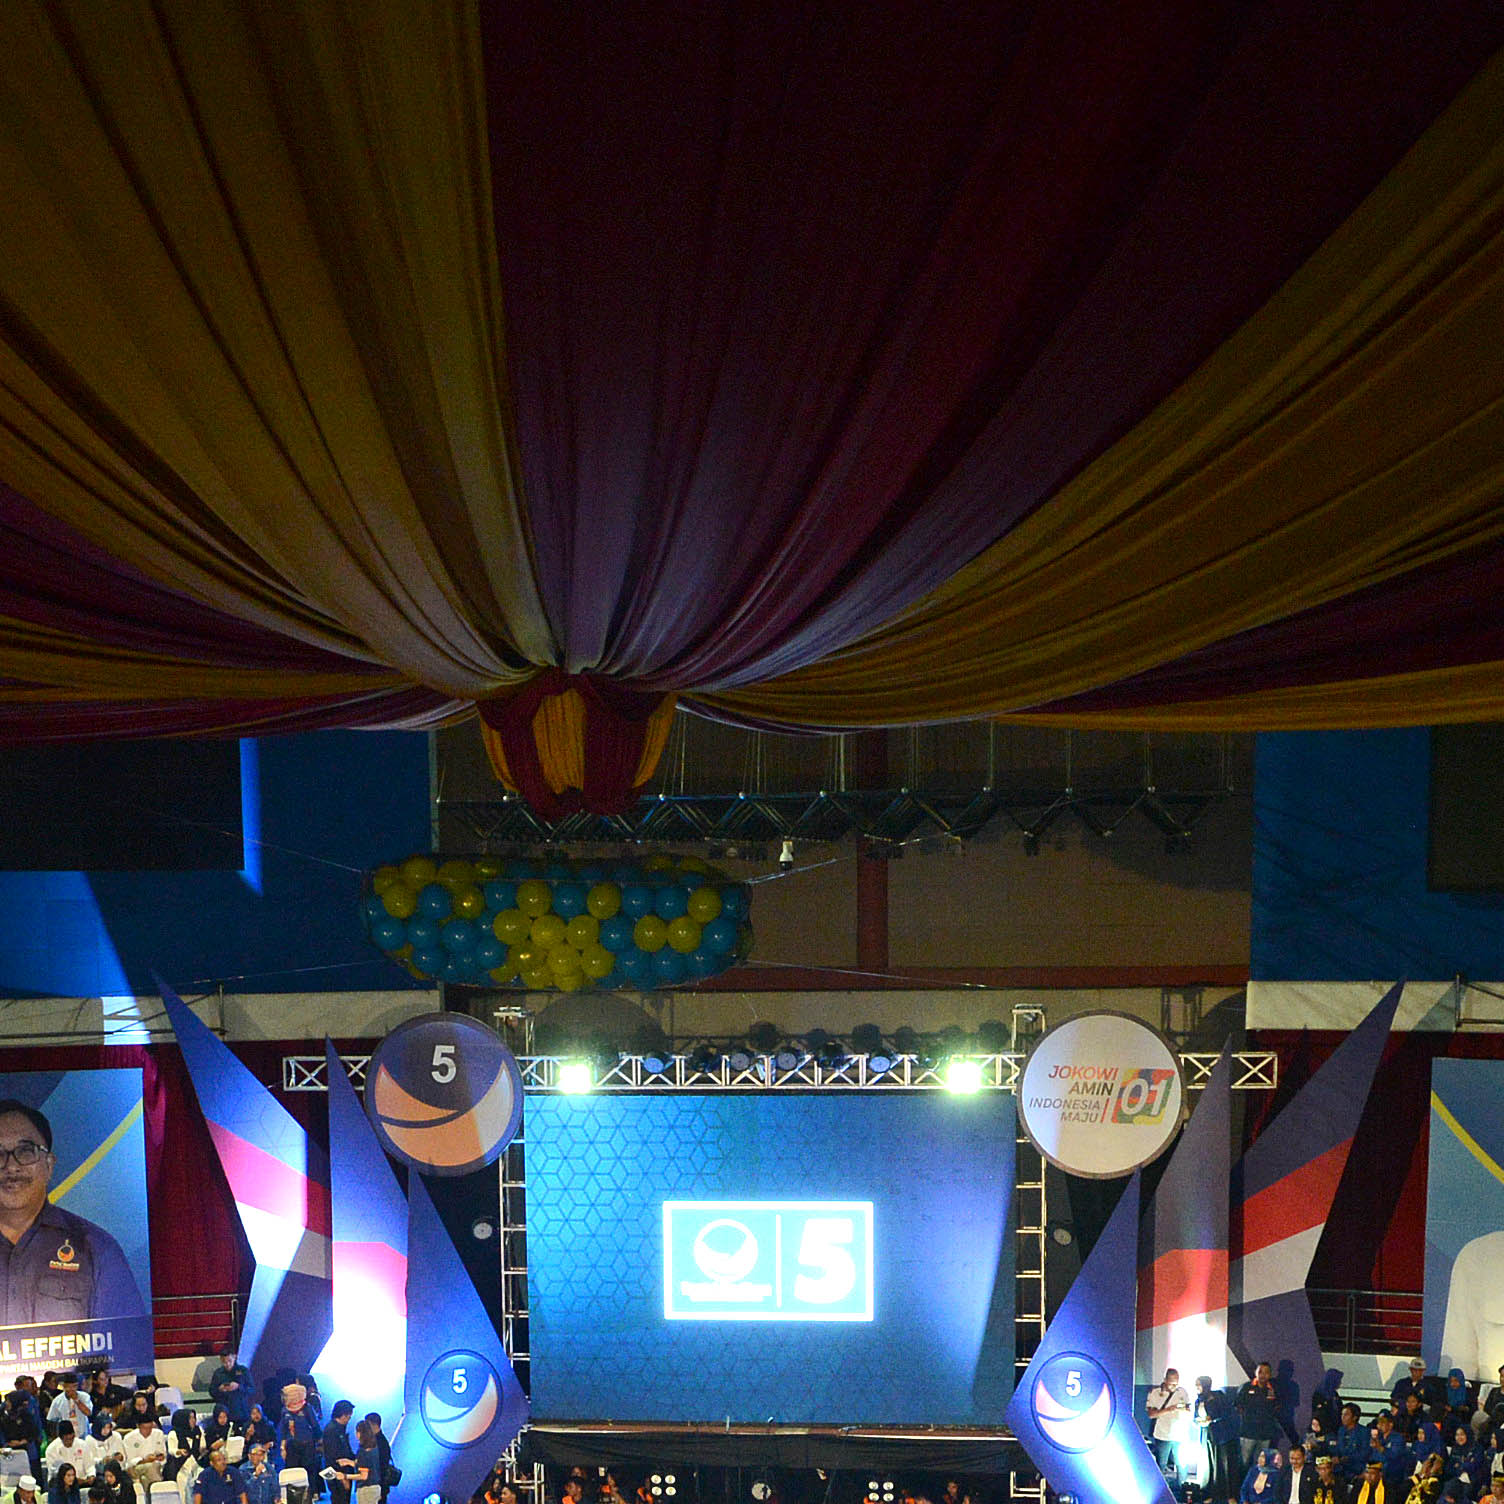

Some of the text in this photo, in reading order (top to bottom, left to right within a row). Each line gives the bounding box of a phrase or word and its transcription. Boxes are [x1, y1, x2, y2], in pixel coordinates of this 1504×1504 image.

[431, 1045, 456, 1083] 5
[1048, 1065, 1119, 1080] JOKOWI
[1069, 1082, 1114, 1096] AMIN
[1121, 1078, 1169, 1116] 01
[1029, 1097, 1100, 1110] INDONESIA
[1060, 1111, 1099, 1123] MAJU
[795, 1218, 857, 1304] 5
[21, 1332, 113, 1359] EFFENDI
[453, 1368, 468, 1394] 5
[1065, 1371, 1081, 1397] 5
